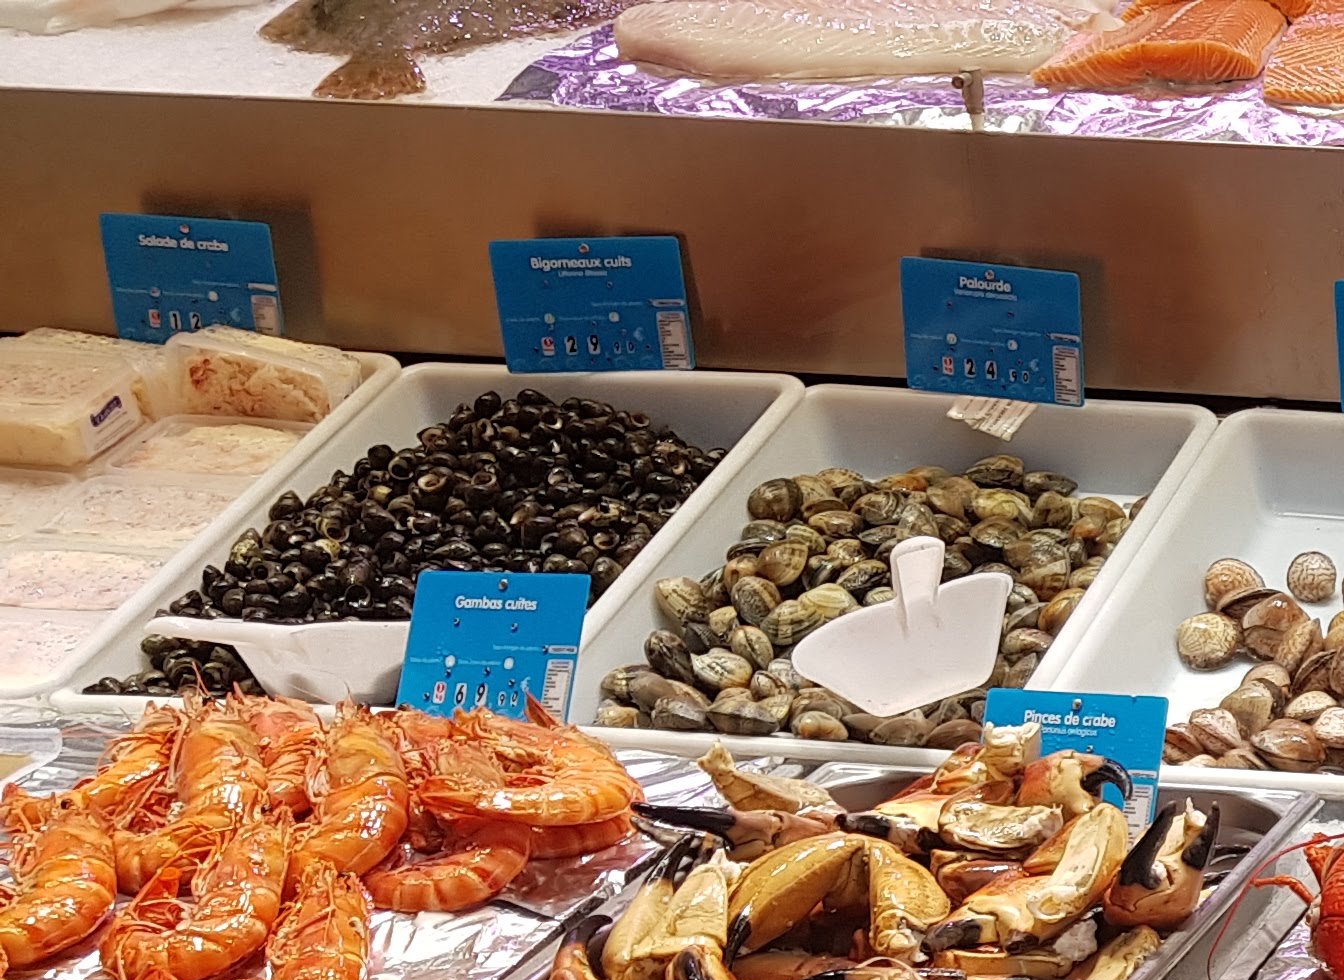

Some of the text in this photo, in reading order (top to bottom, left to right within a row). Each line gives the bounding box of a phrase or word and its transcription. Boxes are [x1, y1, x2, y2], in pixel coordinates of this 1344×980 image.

[138, 234, 229, 251] Salade de crabe
[530, 255, 632, 271] Bigorneaux cuits
[960, 276, 1012, 292] Palourde
[455, 596, 537, 610] Gambas cuites
[1024, 709, 1116, 727] Pinces de crabe
